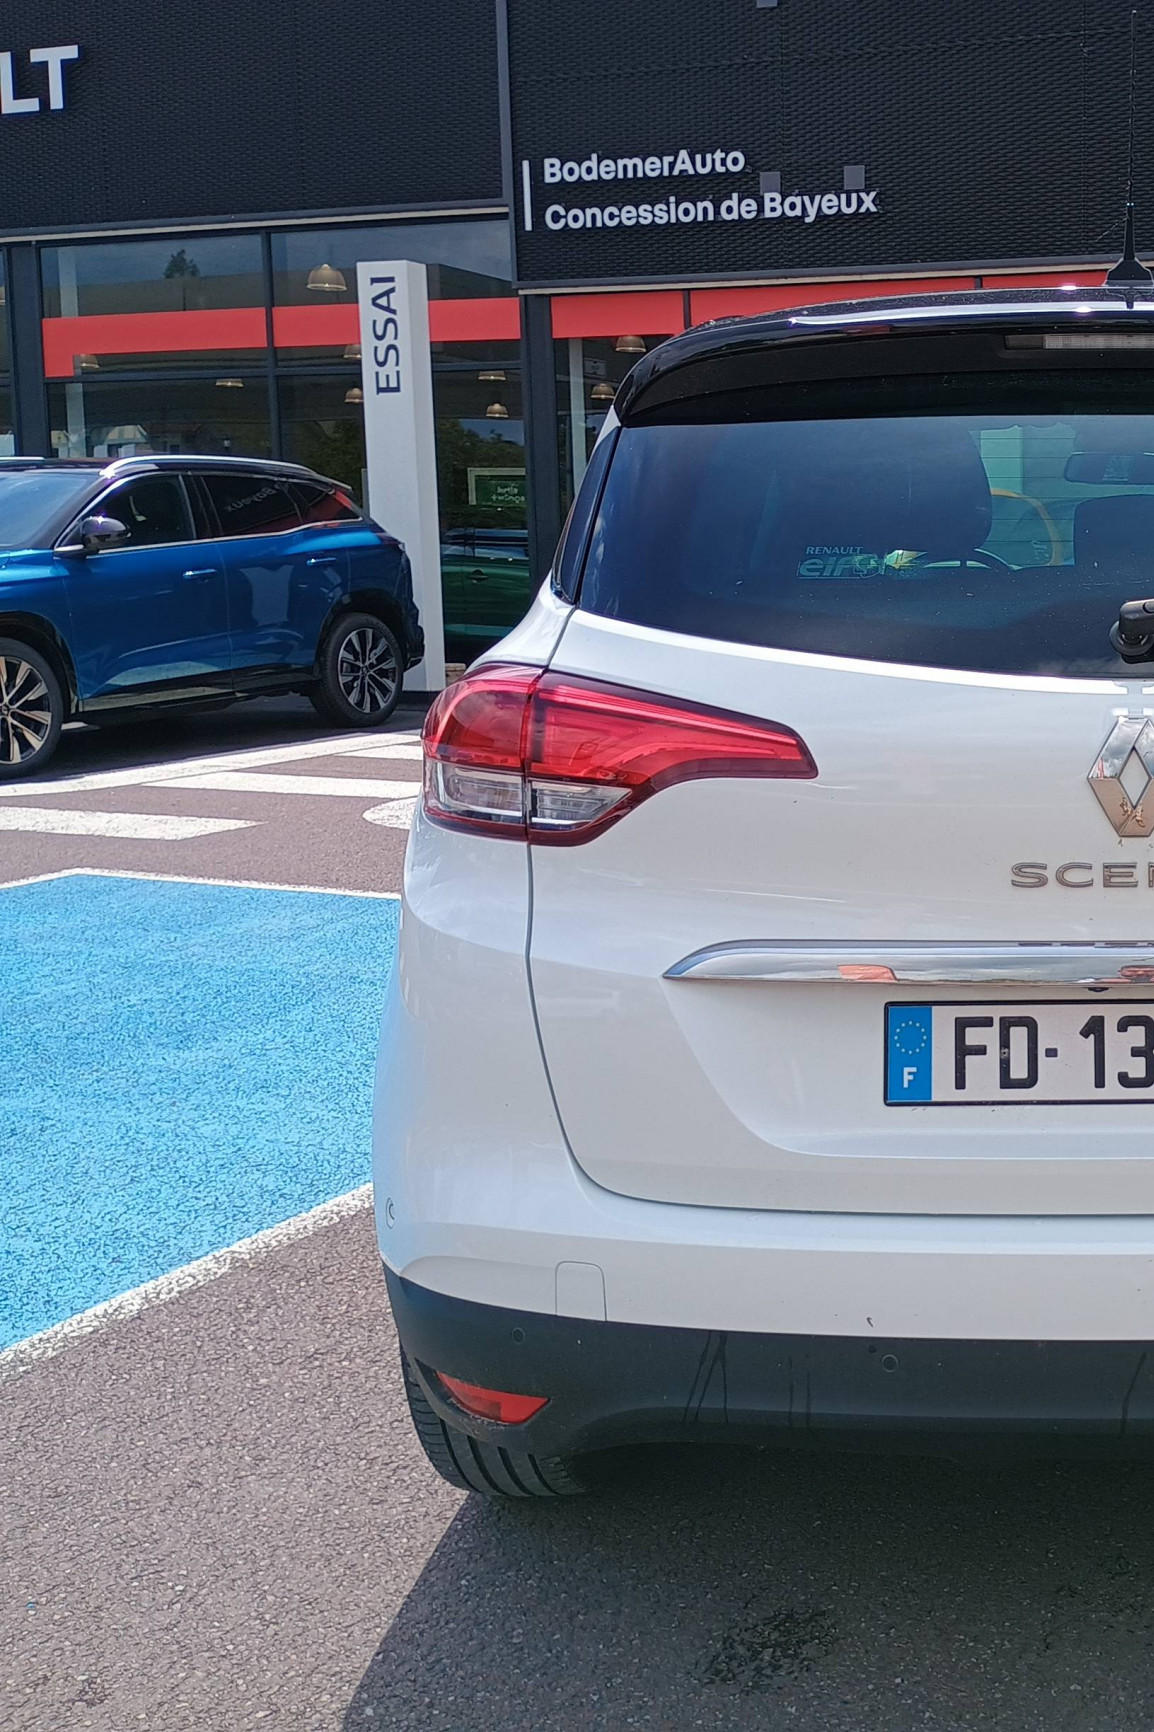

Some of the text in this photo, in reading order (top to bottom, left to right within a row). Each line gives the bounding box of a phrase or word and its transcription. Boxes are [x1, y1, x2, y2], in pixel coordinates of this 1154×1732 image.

[543, 149, 746, 183] BodemerAuto
[544, 190, 878, 231] Concession de Bayeux
[370, 276, 401, 395] ESSAI
[806, 546, 863, 555] RENAULT
[902, 1067, 917, 1089] F
